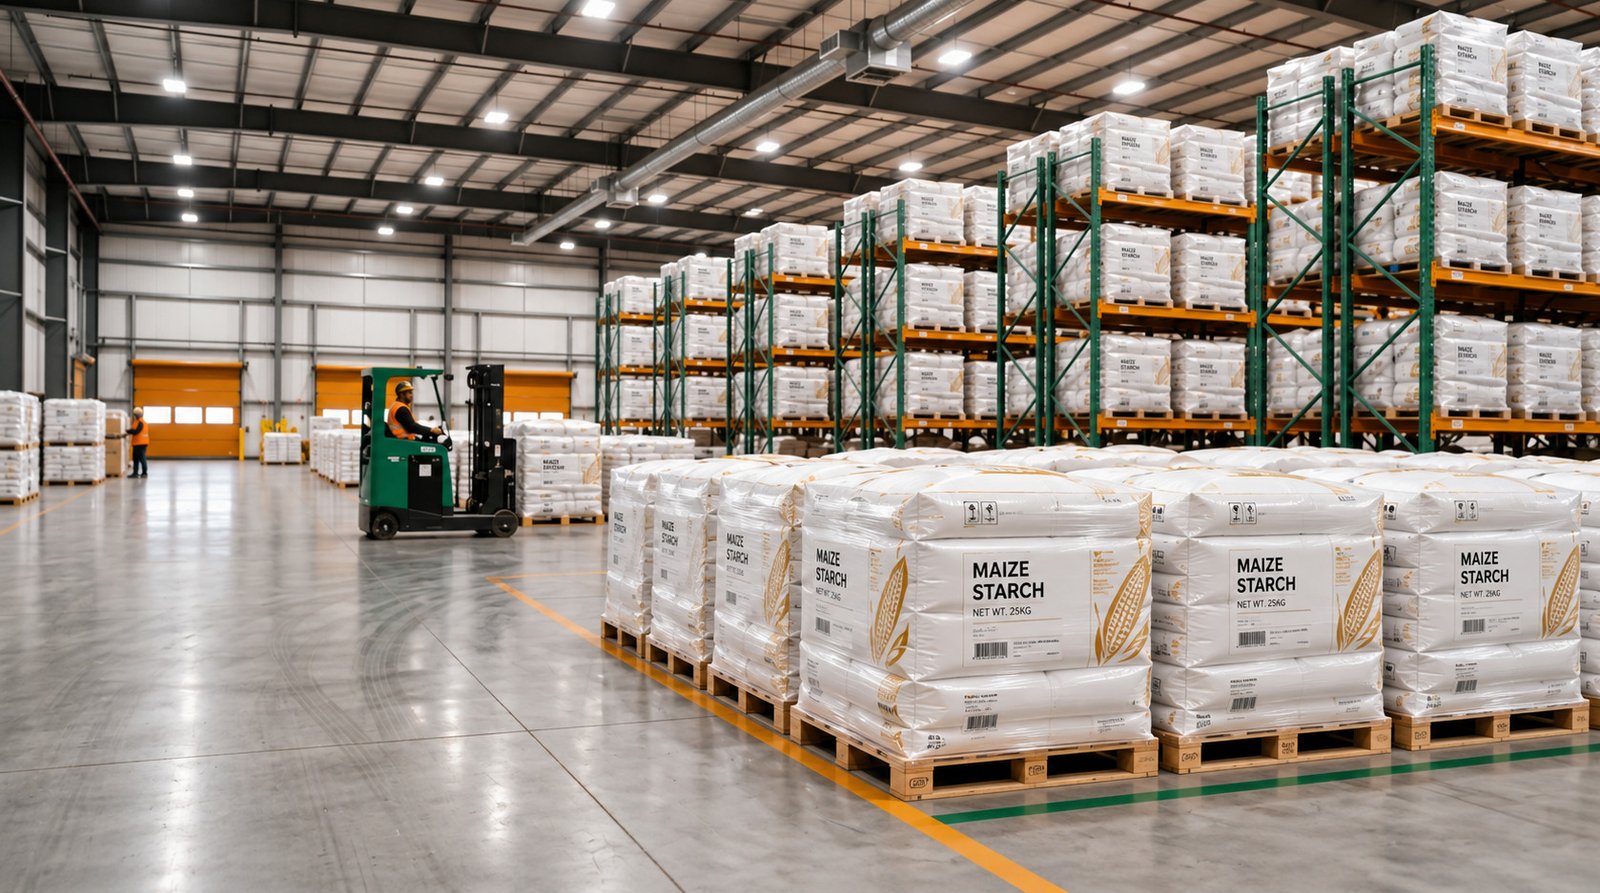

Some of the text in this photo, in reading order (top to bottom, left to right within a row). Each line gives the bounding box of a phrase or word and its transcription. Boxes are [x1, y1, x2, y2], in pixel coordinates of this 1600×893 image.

[727, 548, 748, 565] STARCH
[816, 548, 840, 567] MAIZE
[1461, 551, 1499, 566] MAIZE
[973, 561, 1029, 578] MAIZE
[1237, 557, 1283, 573] MAIZE
[816, 567, 847, 588] STARCH
[1237, 576, 1296, 593] STARCH
[1461, 569, 1509, 584] STARCH
[973, 582, 1044, 600] STARCH
[1474, 590, 1485, 598] WT.
[973, 606, 1032, 617] NET WT. 25KG
[1237, 600, 1251, 608] NET
[1253, 600, 1267, 608] WT.
